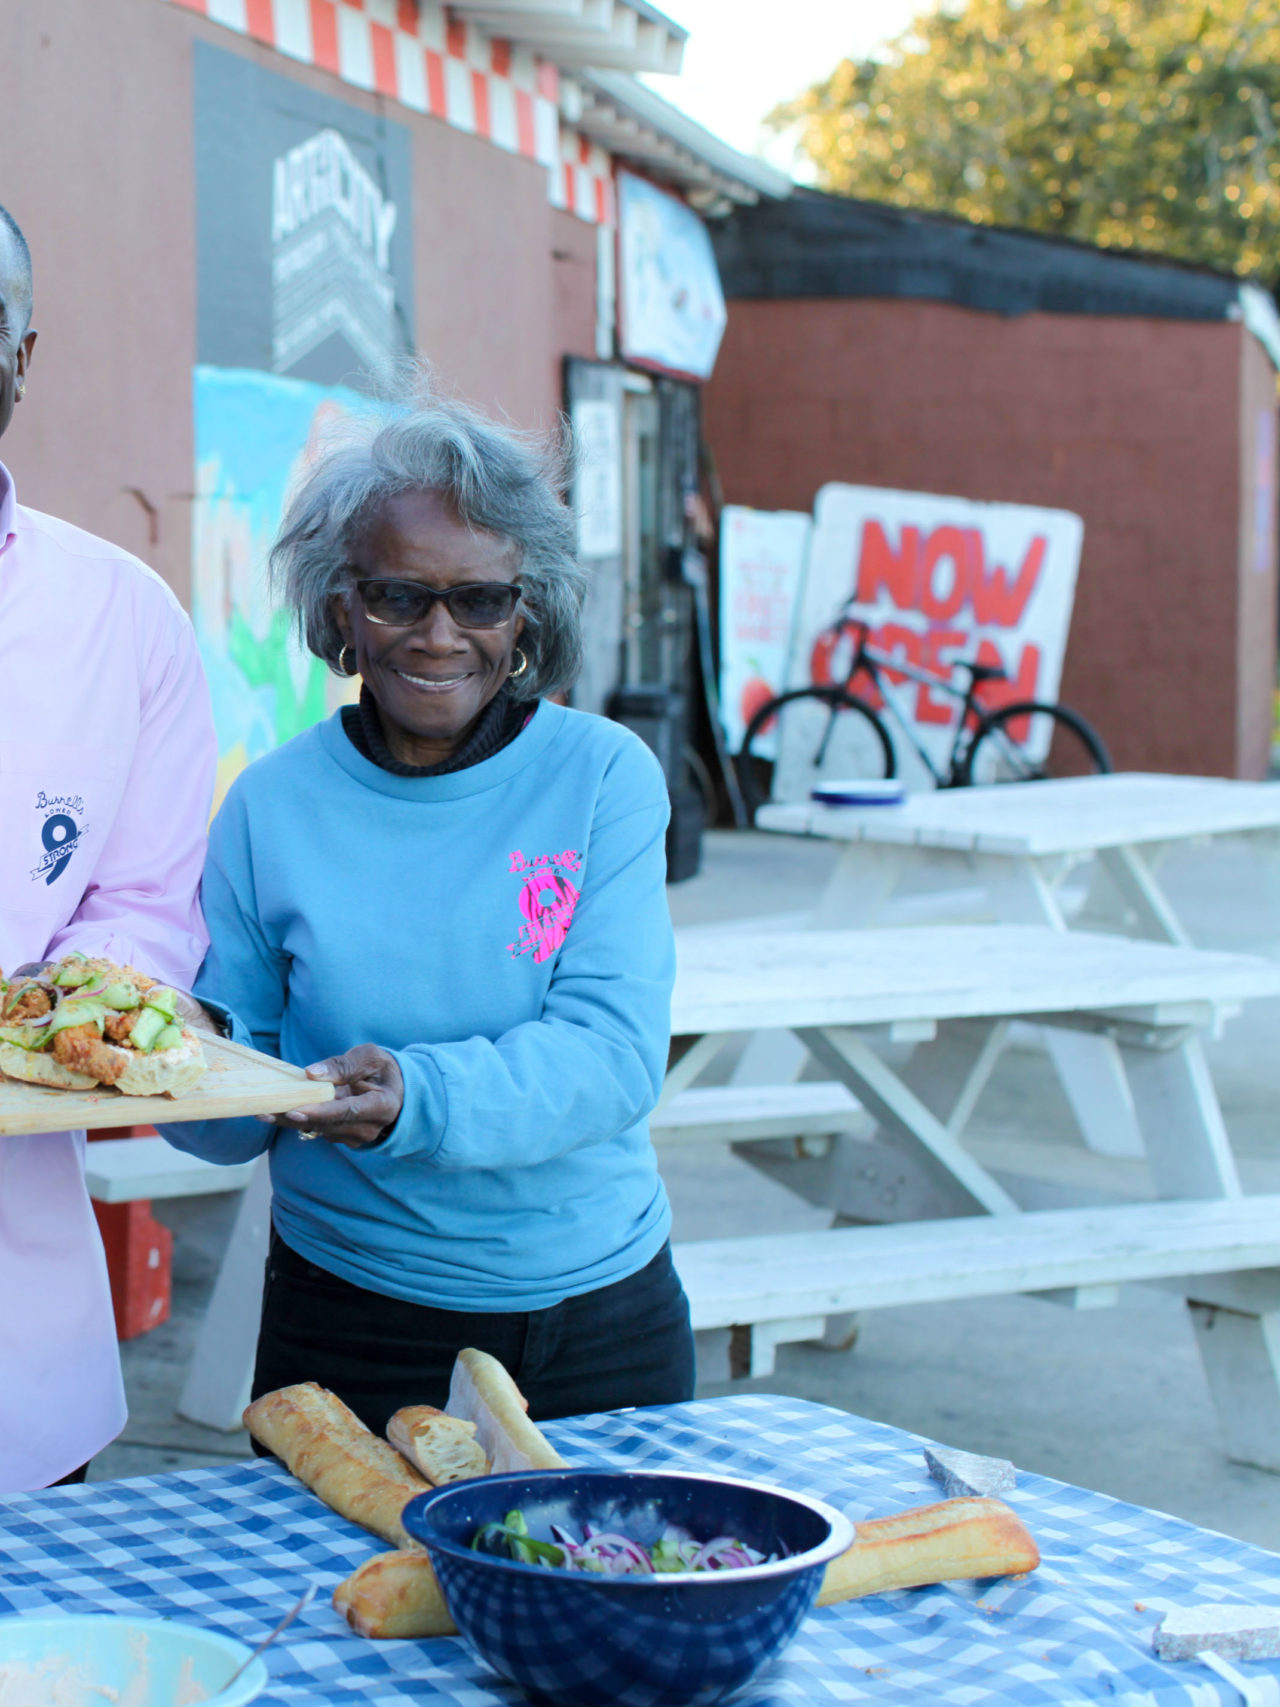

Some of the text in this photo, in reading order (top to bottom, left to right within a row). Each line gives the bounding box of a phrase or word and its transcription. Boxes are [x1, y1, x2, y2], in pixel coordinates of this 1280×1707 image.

[857, 518, 1047, 628] NOW
[811, 620, 1040, 745] OPEN
[41, 813, 77, 886] 9
[43, 839, 79, 866] STRONG
